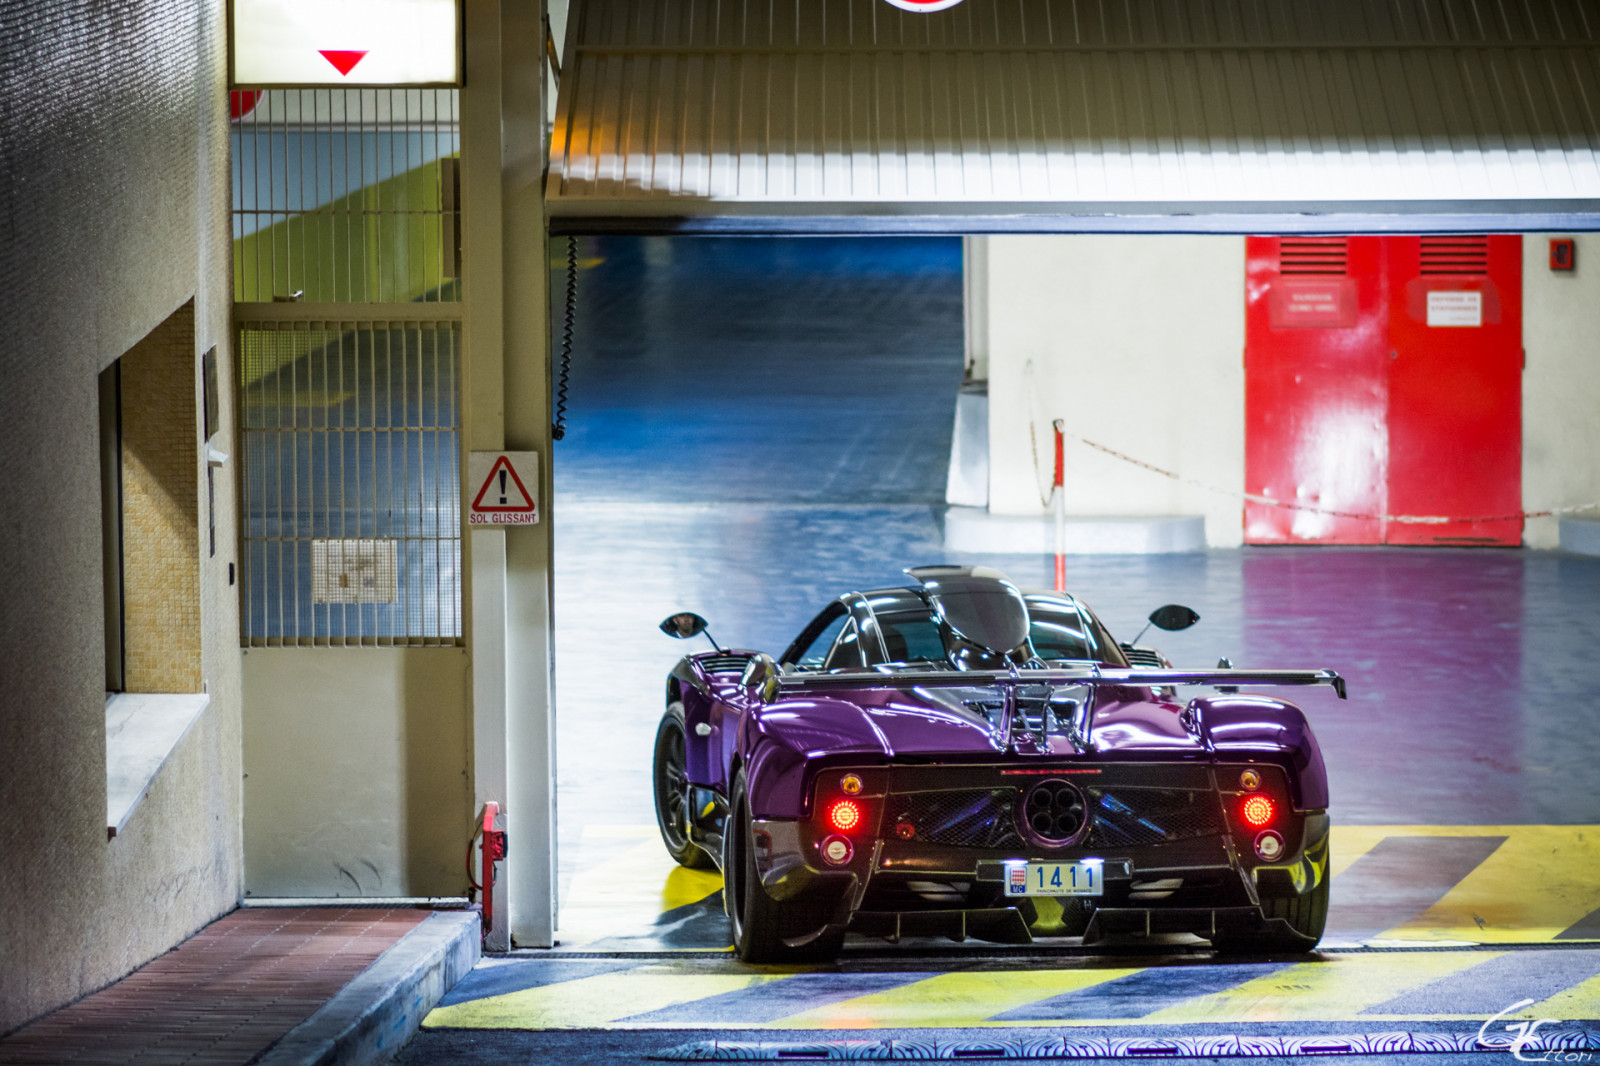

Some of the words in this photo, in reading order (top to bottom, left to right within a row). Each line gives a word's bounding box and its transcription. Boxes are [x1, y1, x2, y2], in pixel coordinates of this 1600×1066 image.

[470, 513, 488, 524] SOL
[492, 513, 536, 524] GLISSANT
[1037, 866, 1093, 888] 1411
[1012, 885, 1023, 893] MC
